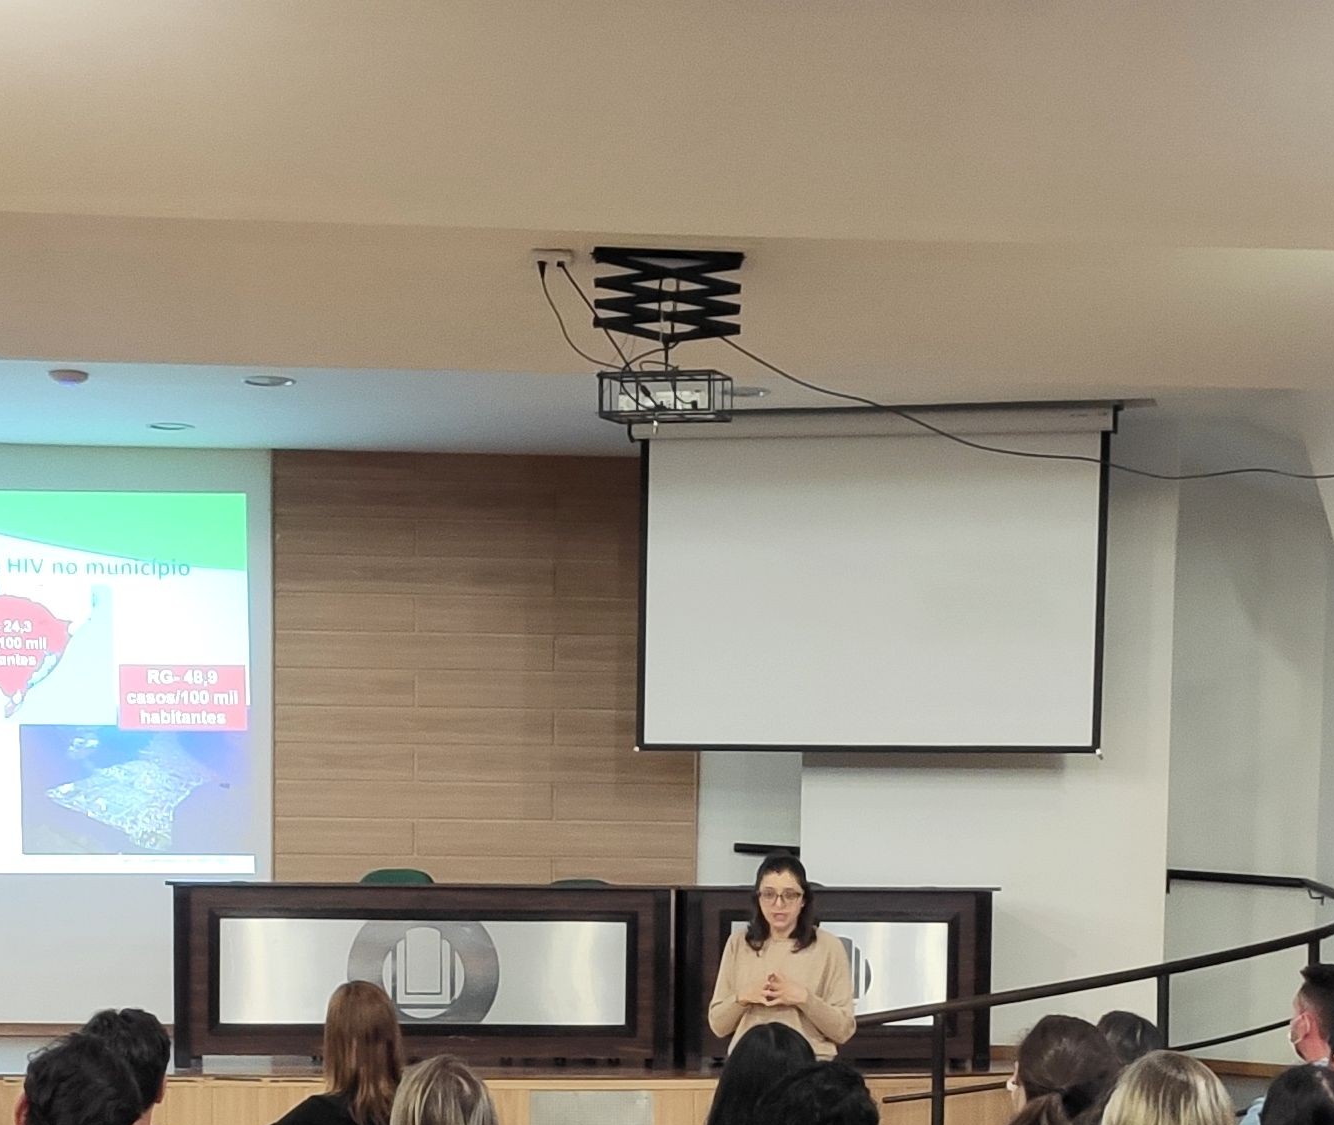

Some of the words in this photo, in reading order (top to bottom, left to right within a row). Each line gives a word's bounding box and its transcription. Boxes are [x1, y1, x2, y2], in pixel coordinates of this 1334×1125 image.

[7, 558, 44, 574] HIV
[52, 561, 77, 575] no
[86, 557, 190, 580] município
[25, 636, 47, 650] mil
[183, 669, 219, 687] 48,9
[127, 689, 210, 705] casos/100
[213, 690, 239, 705] mil
[140, 709, 227, 725] habitantes
